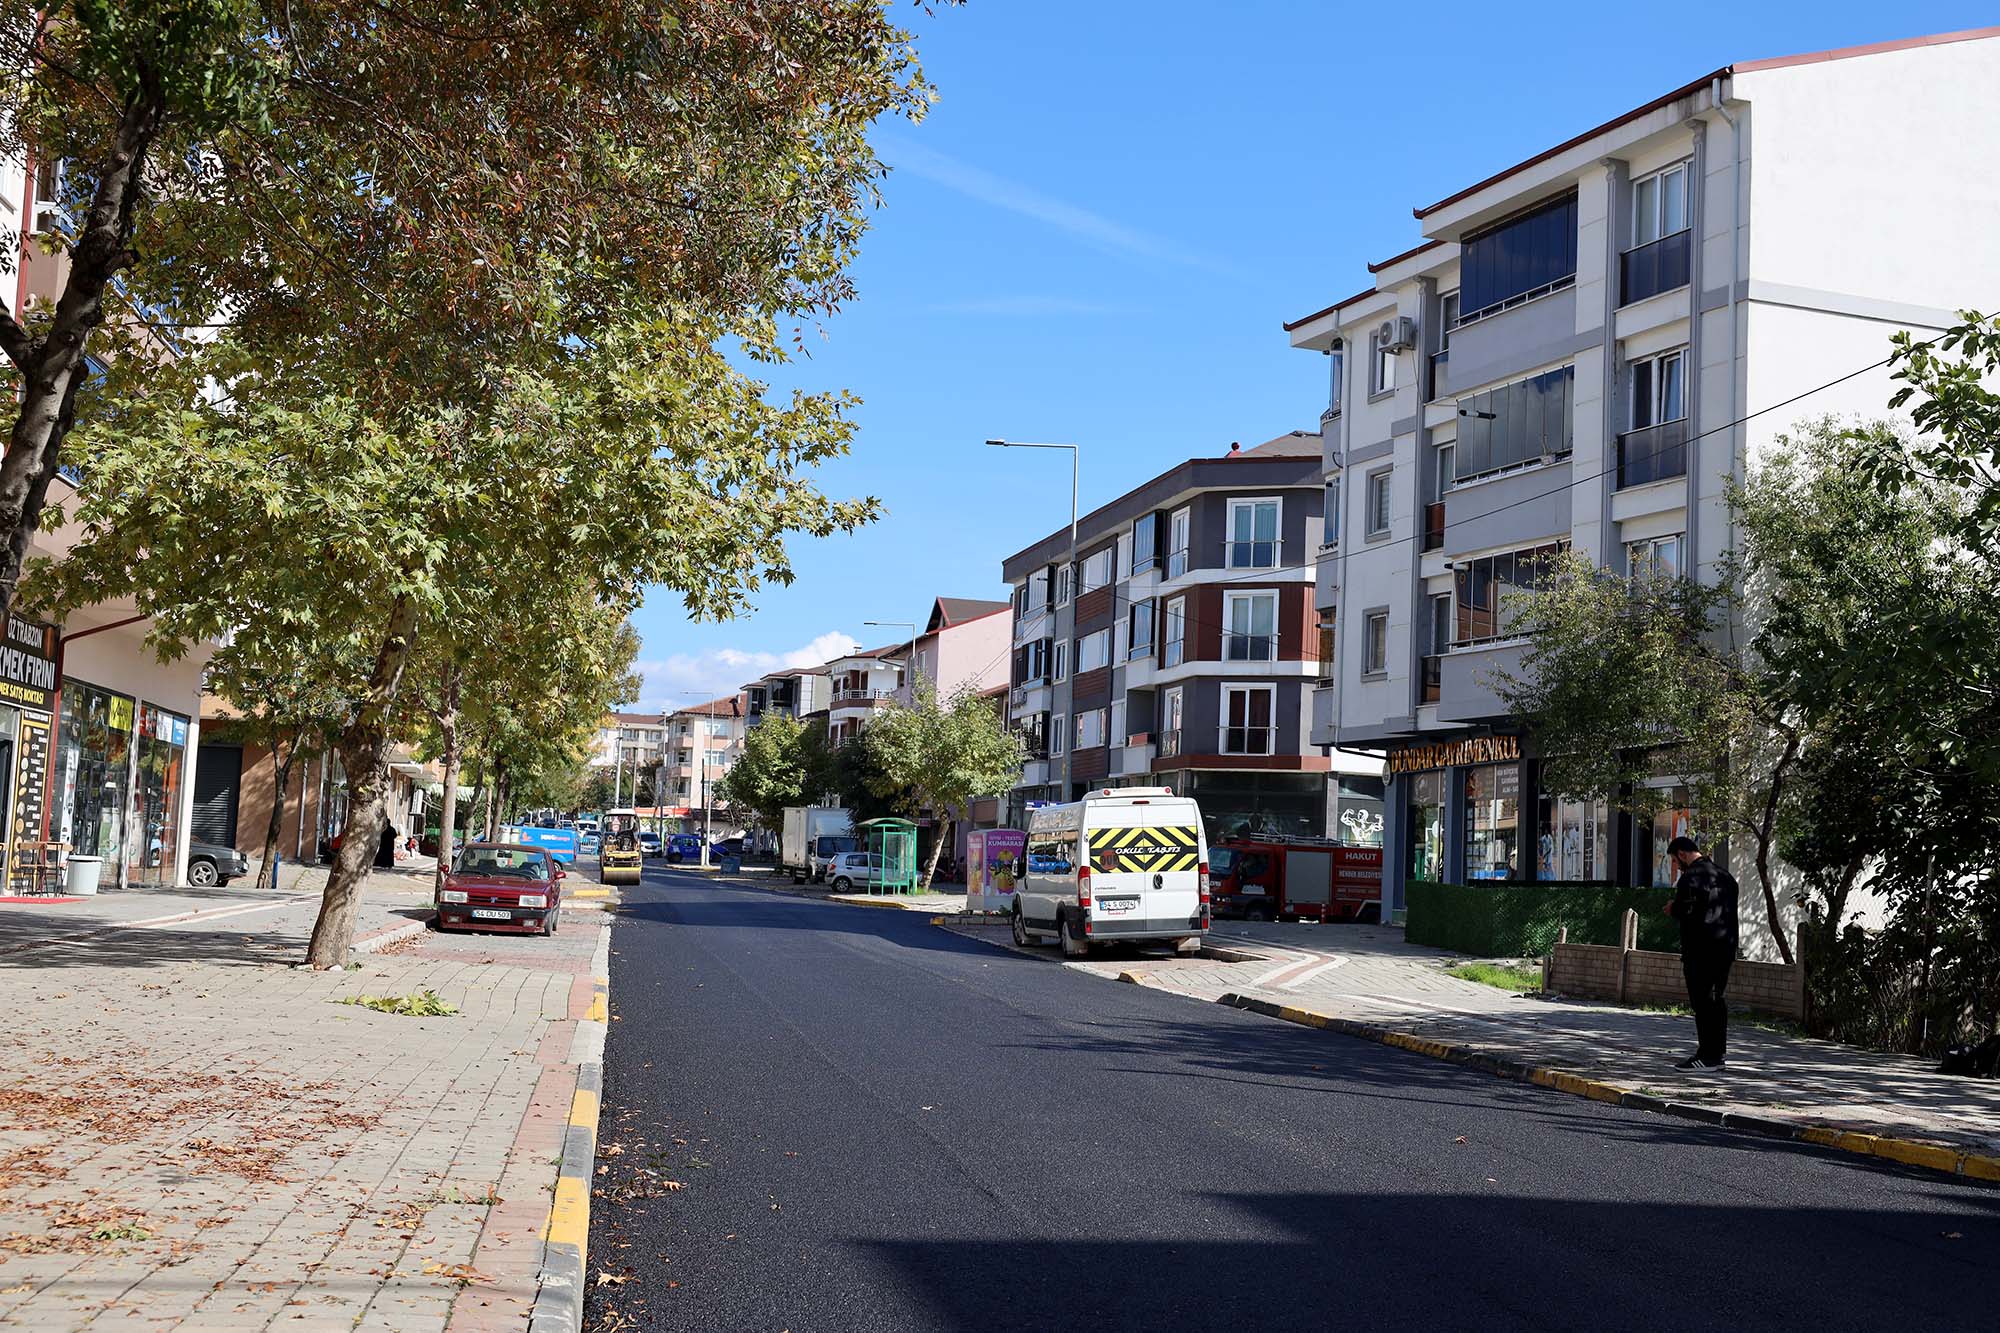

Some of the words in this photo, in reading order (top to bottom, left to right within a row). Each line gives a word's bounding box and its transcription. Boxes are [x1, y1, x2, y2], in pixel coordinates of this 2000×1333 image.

[17, 621, 44, 649] TRABZON
[1115, 847, 1144, 855] OKUL
[1345, 852, 1377, 860] HAKUT
